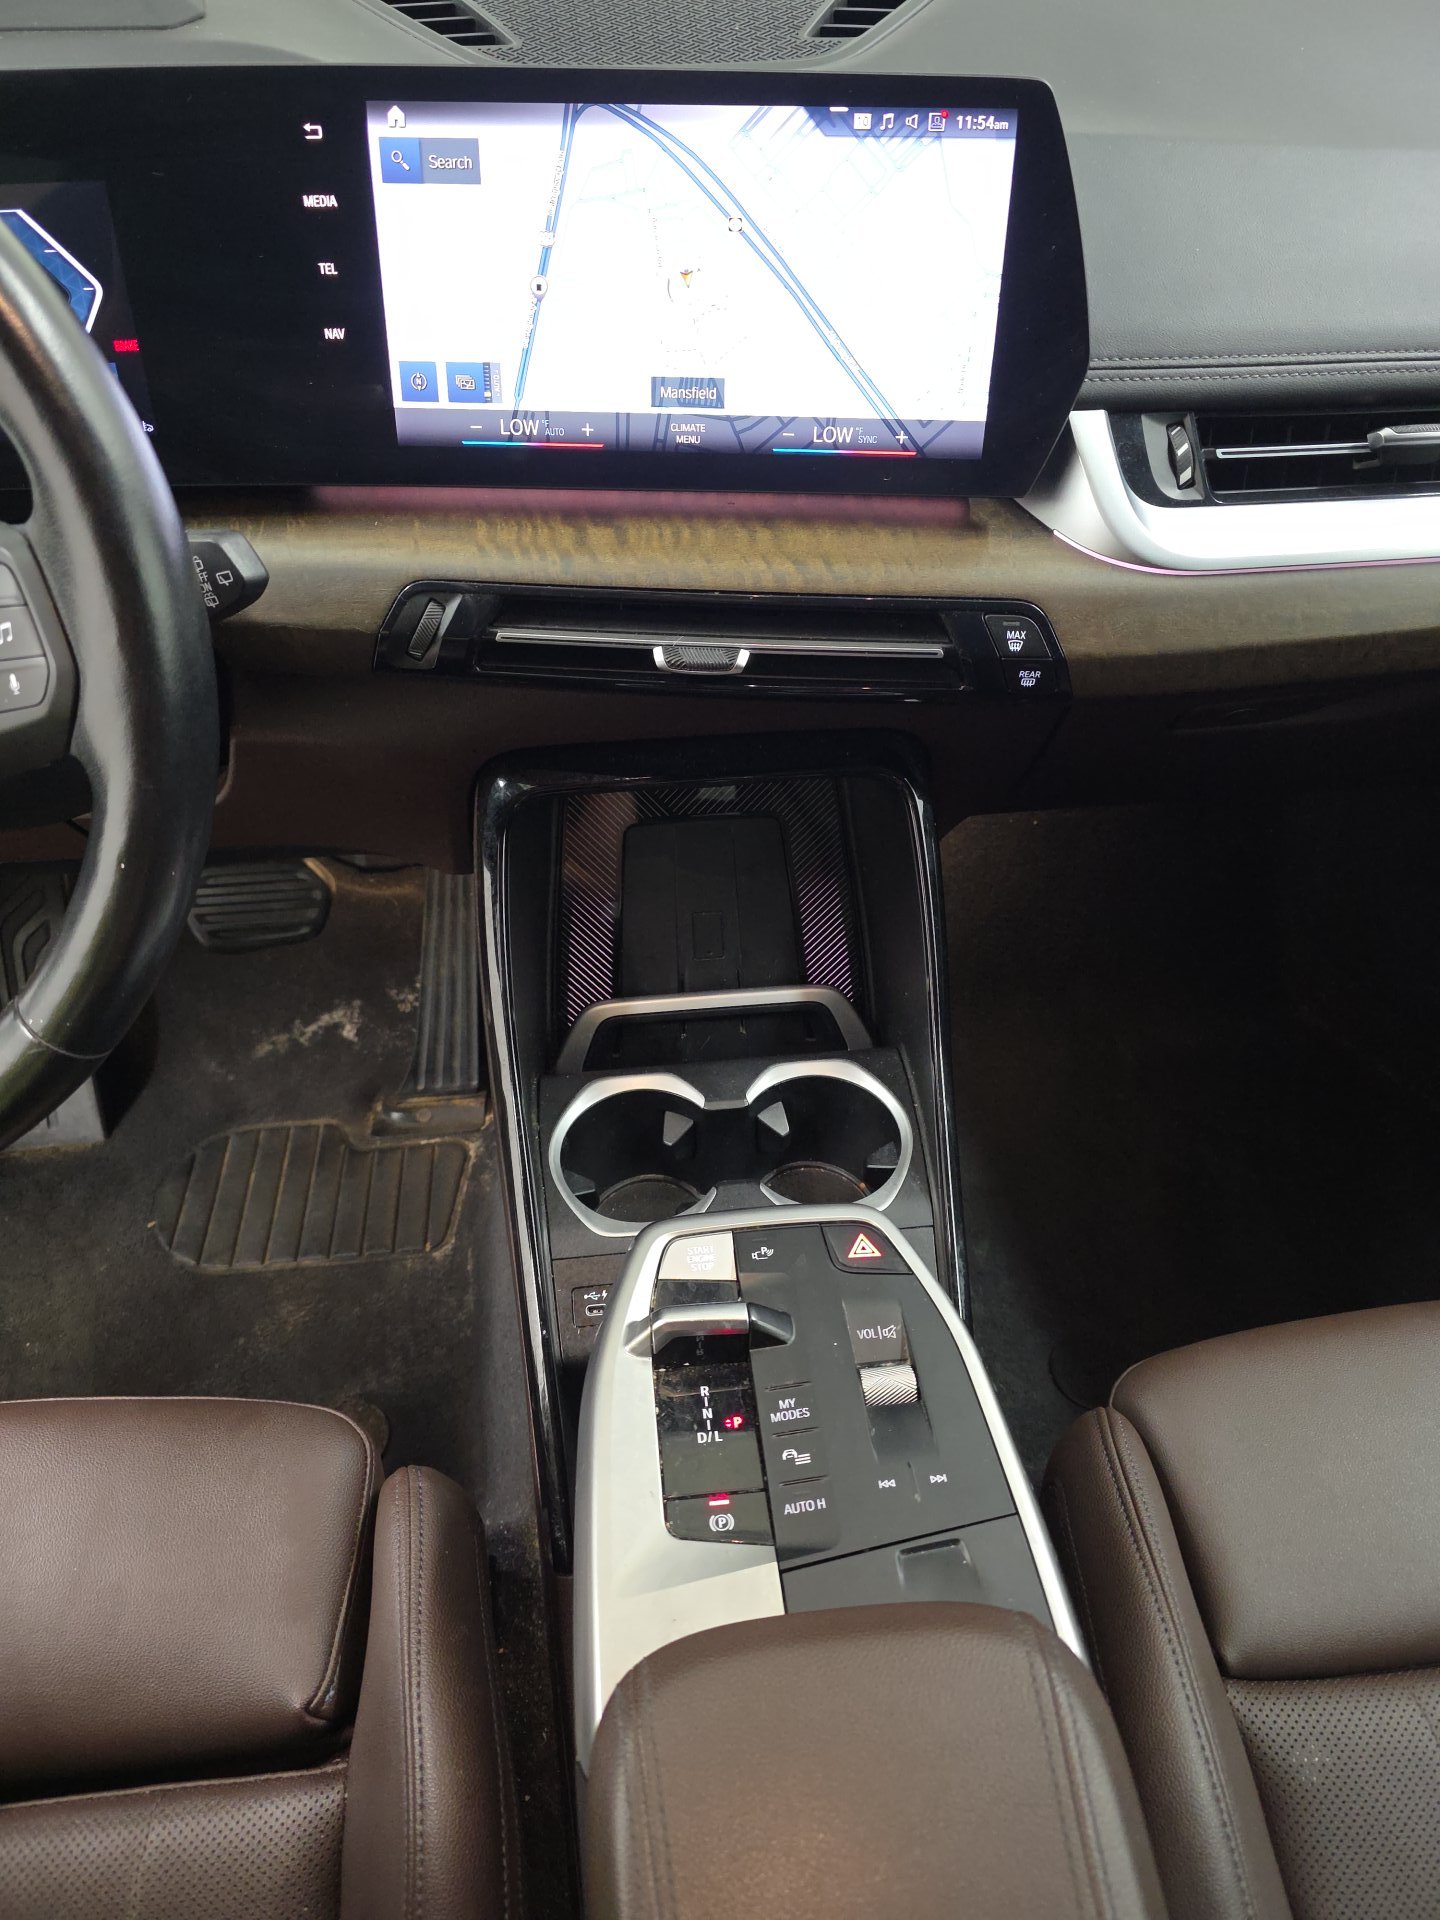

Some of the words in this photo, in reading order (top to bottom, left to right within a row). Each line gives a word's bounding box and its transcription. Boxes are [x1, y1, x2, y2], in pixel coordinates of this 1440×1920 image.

[956, 115, 1009, 130] 11:54am
[428, 154, 473, 169] Search
[302, 194, 338, 207] MEDIA
[317, 262, 338, 275] TEL
[323, 327, 345, 340] NAV
[660, 386, 717, 401] Mansfield
[499, 418, 540, 436] LOW
[544, 427, 565, 437] AUTO
[670, 423, 706, 433] CLIMATE
[675, 434, 701, 444] MENU
[812, 426, 854, 443] LOW
[857, 434, 878, 444] SYNC
[1006, 630, 1027, 640] MAX
[1018, 670, 1042, 679] REAR
[687, 1245, 714, 1255] START
[691, 1263, 715, 1272] STOP
[856, 1327, 878, 1340] VOL
[700, 1385, 710, 1397] R
[778, 1397, 797, 1410] MY
[702, 1407, 713, 1419] N
[770, 1407, 811, 1423] MODES
[733, 1416, 743, 1429] P
[783, 1499, 816, 1515] AUTO
[816, 1497, 827, 1511] H
